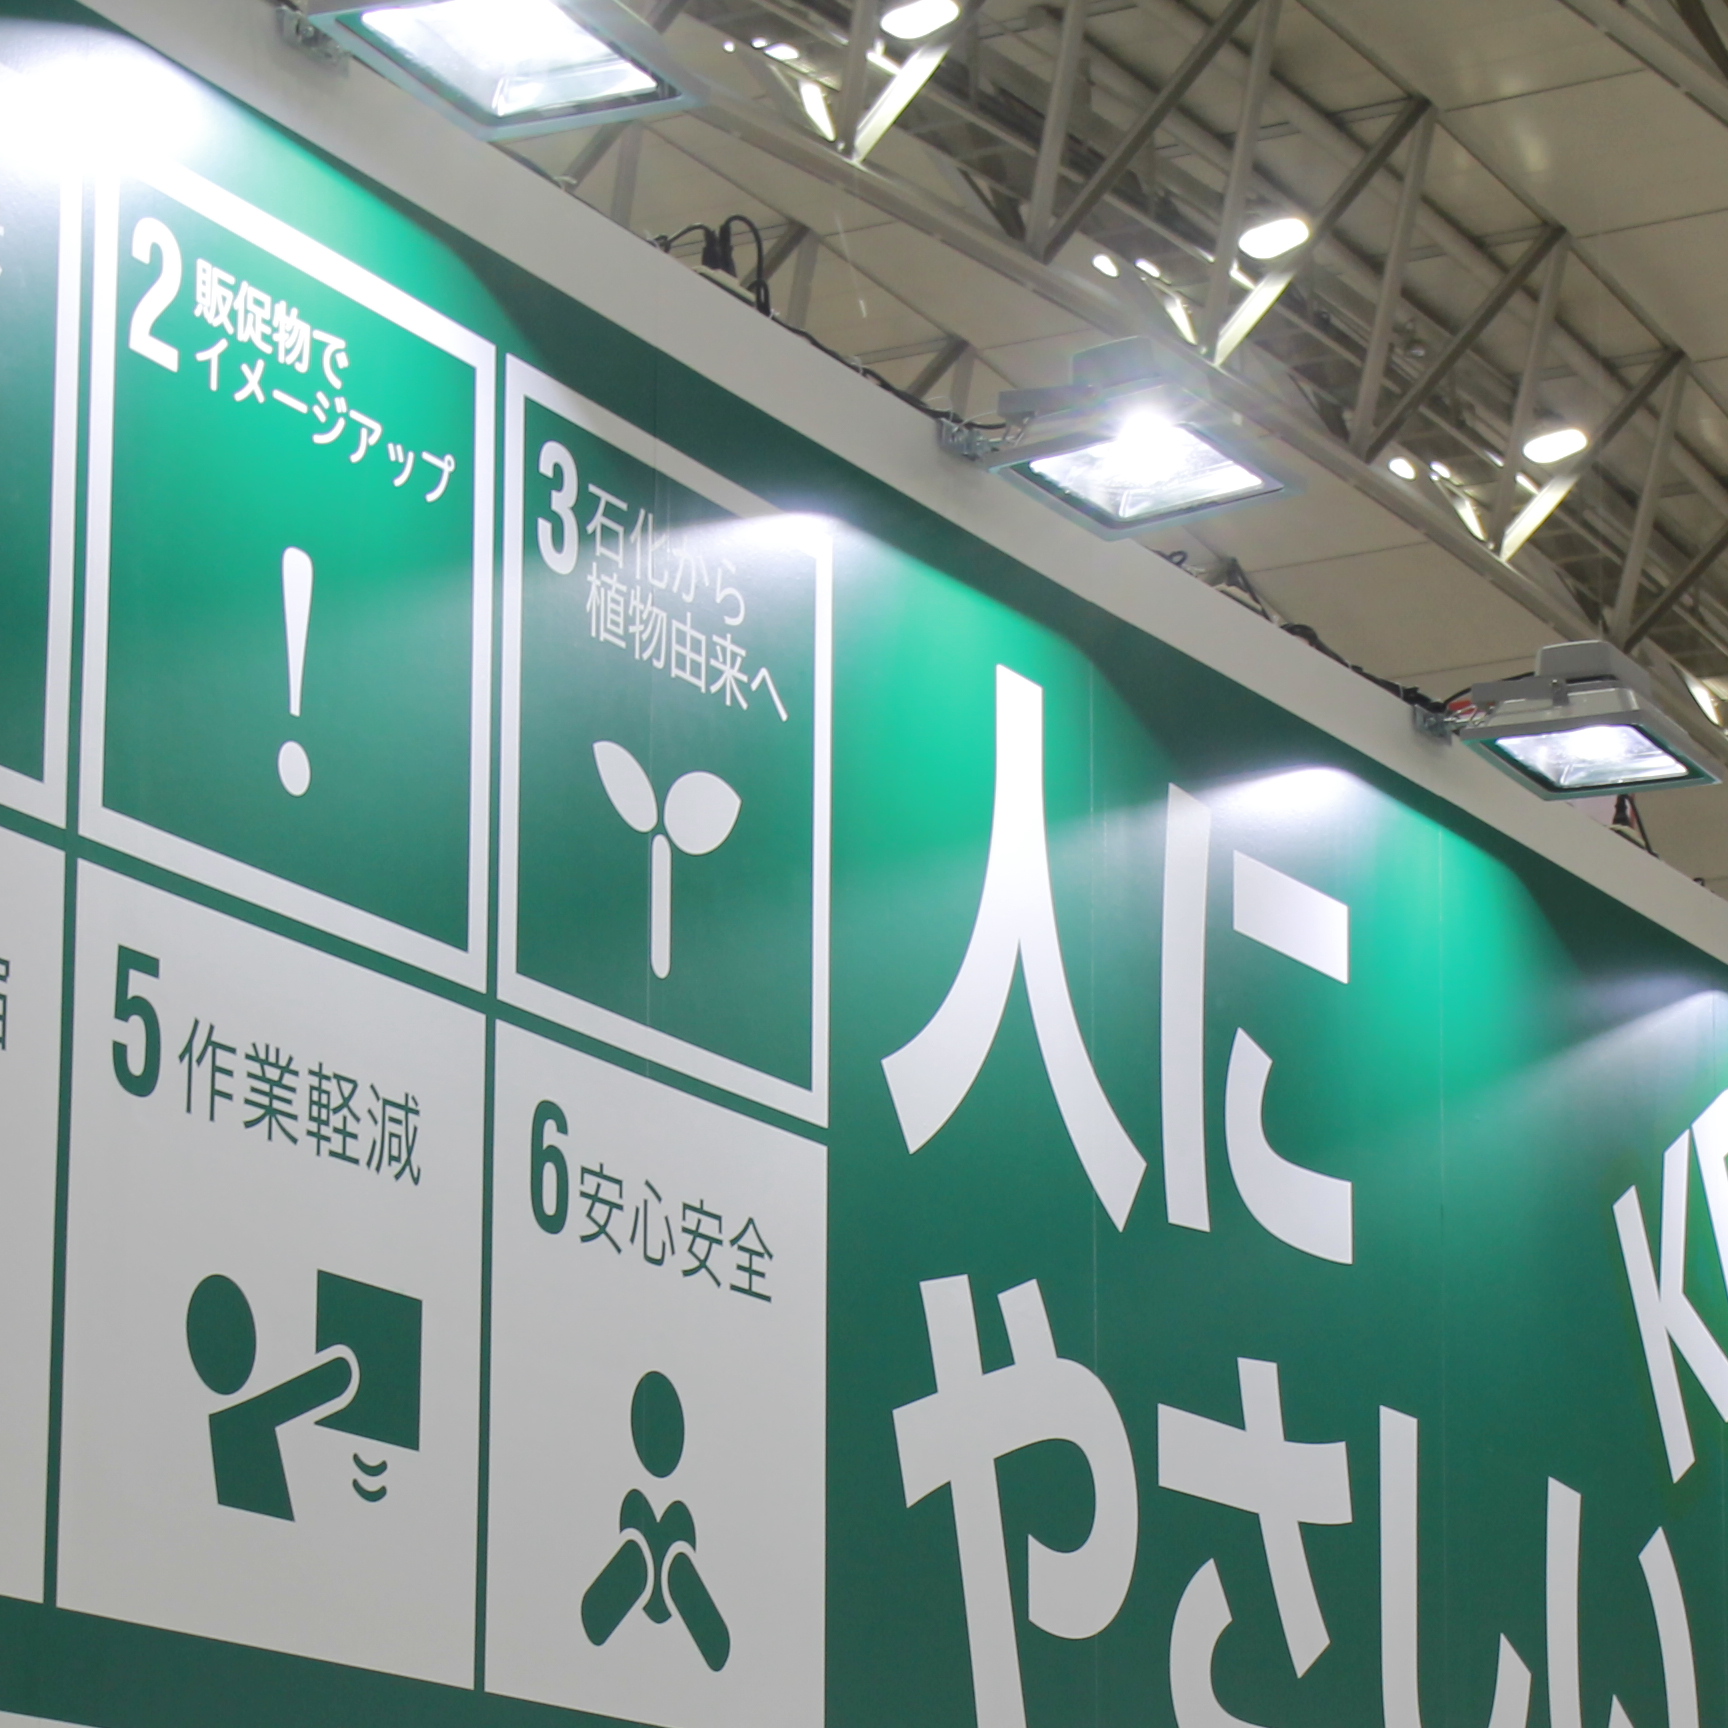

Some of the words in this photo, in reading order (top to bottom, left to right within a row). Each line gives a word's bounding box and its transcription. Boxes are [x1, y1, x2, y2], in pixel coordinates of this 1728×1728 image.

[128, 216, 183, 376] 2
[192, 257, 351, 393] 販促物で
[192, 337, 457, 506] イメージアップ
[536, 439, 580, 576] 3
[583, 482, 750, 630] 石化から
[585, 556, 790, 722] 植物由来へ
[881, 662, 1354, 1266] 人に
[110, 943, 162, 1101] 5
[178, 1016, 423, 1188] 作業軽減
[529, 1099, 570, 1235] 6
[577, 1160, 776, 1305] 安心安全
